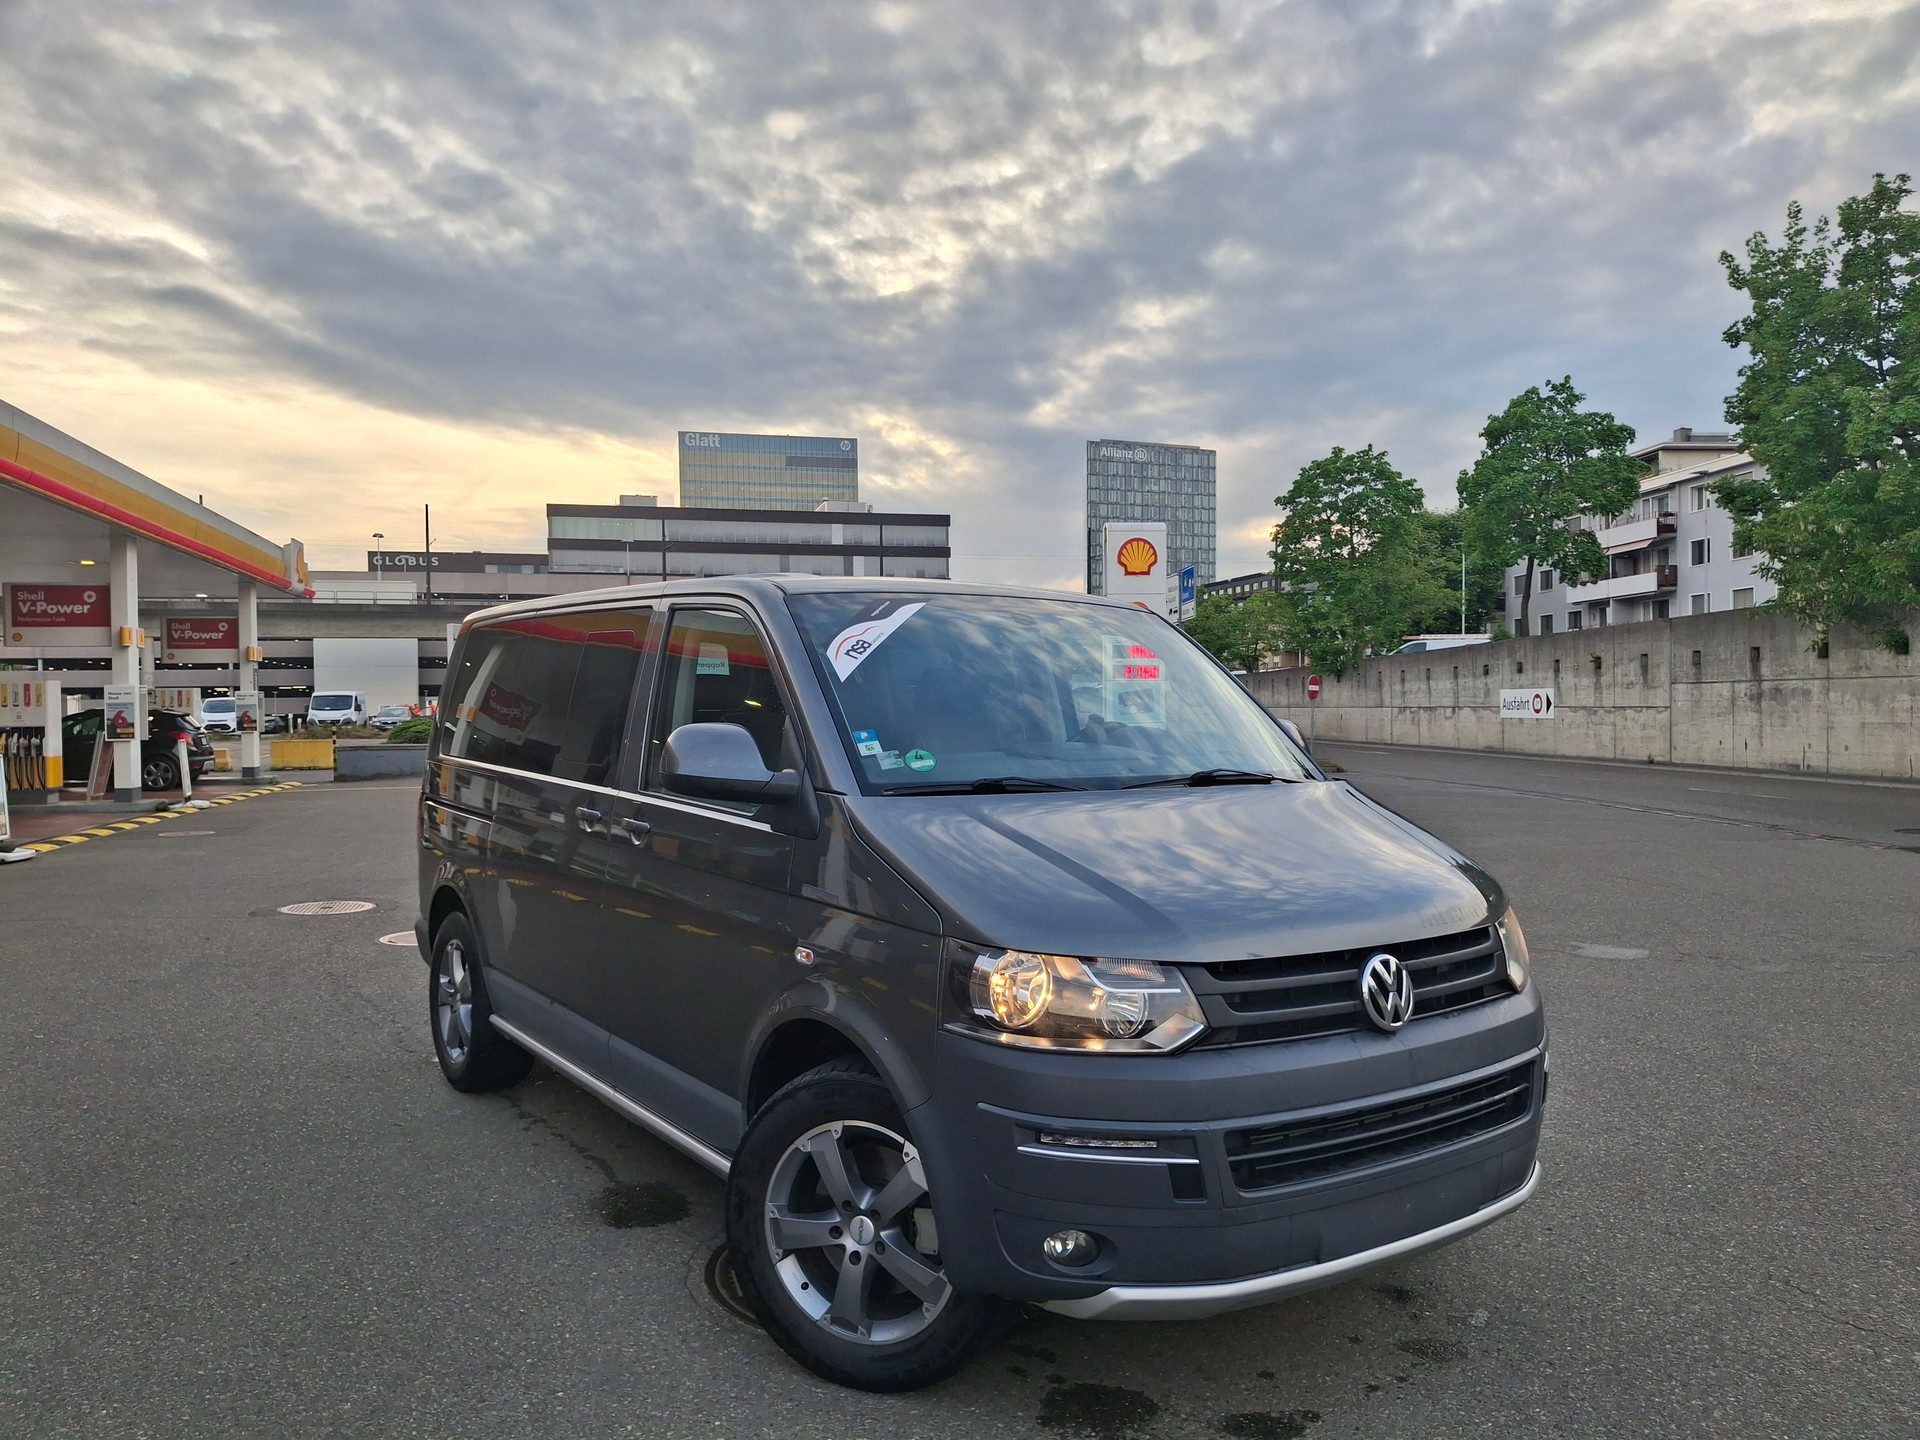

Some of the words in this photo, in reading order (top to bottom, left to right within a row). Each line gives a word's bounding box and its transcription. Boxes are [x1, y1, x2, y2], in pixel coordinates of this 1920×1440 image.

[684, 432, 721, 448] Glatt
[1101, 446, 1134, 459] Allianz
[373, 555, 439, 566] GLOBUS
[17, 591, 44, 600] Shell
[18, 601, 91, 614] V-Power
[171, 622, 191, 630] Shell
[171, 630, 225, 640] V-Power
[844, 639, 873, 660] nsa
[1502, 696, 1530, 711] Ausfahrt
[914, 750, 924, 760] 4
